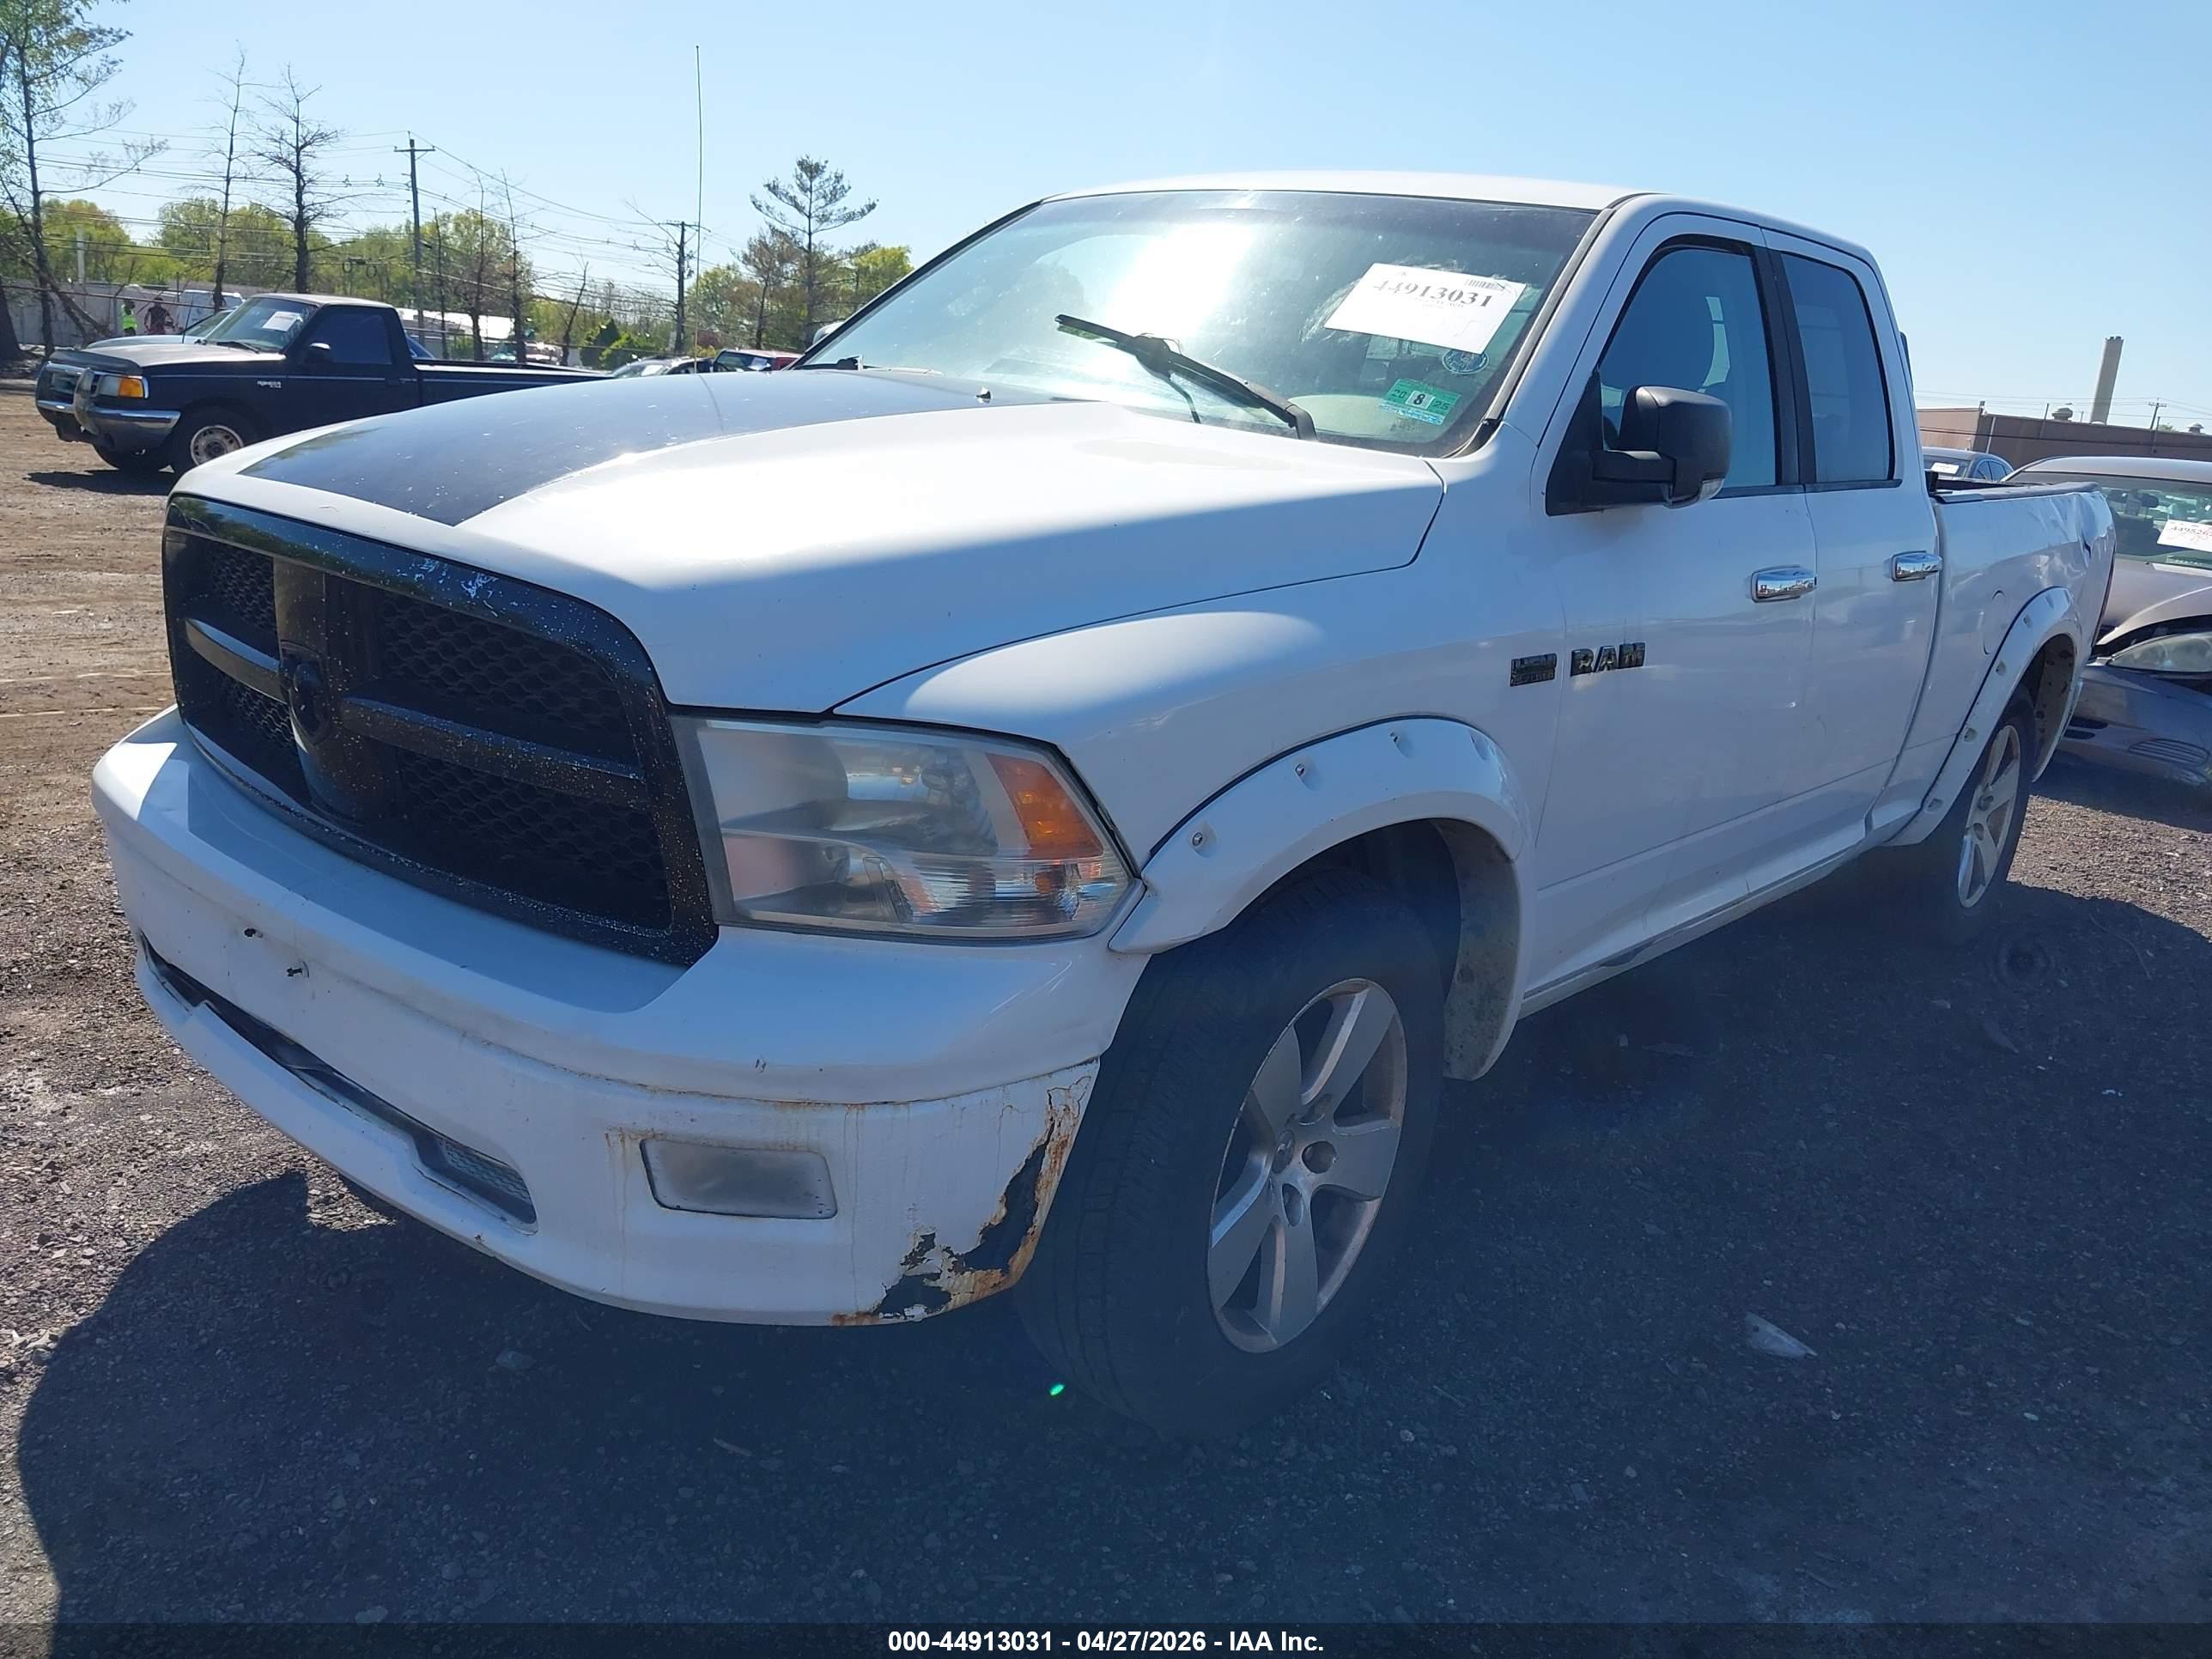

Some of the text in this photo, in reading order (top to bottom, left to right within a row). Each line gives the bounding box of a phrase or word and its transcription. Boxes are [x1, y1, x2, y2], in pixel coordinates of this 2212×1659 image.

[1374, 280, 1492, 307] 44913031
[1391, 389, 1450, 410] 20 8 25
[1571, 641, 1646, 677] RAM
